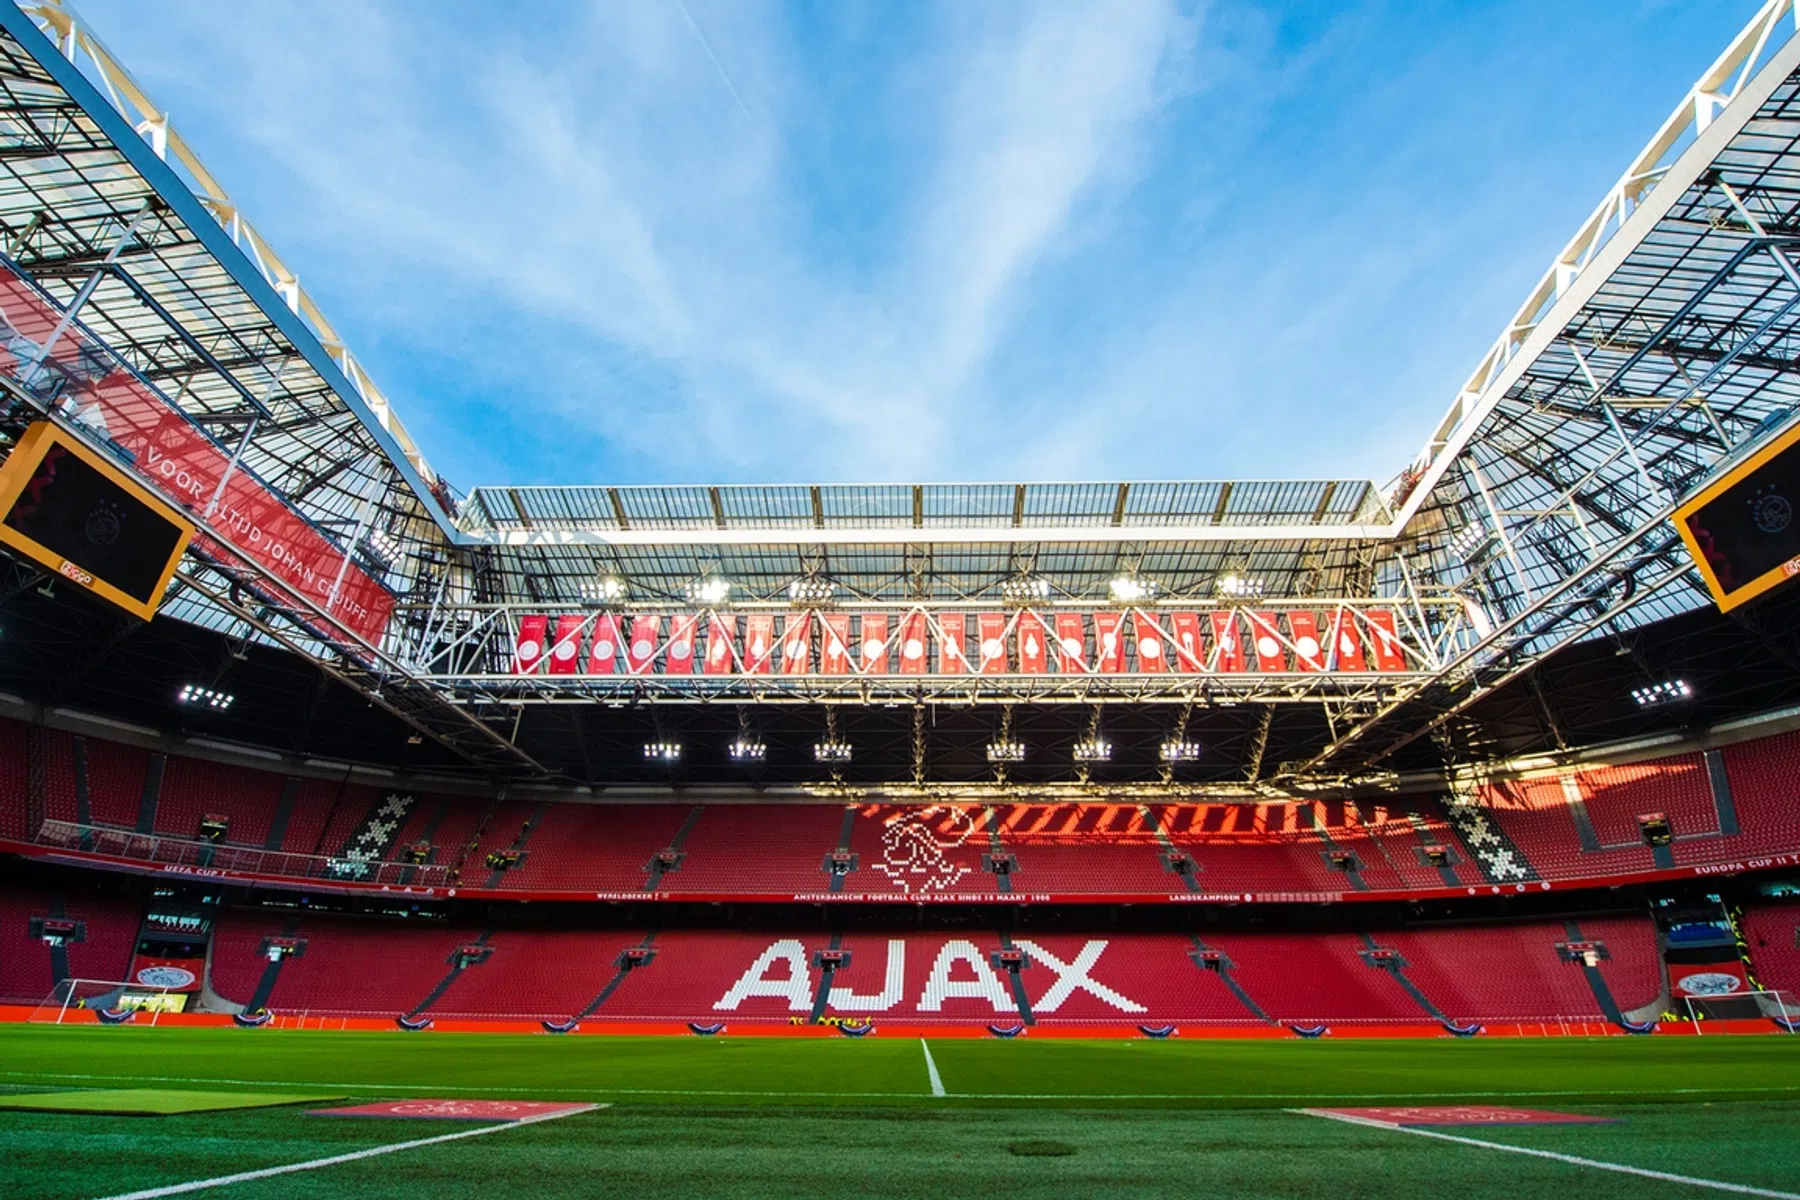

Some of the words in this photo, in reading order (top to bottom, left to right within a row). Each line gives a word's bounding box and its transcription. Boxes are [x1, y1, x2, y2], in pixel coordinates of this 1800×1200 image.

[148, 445, 204, 500] VOOR
[263, 539, 316, 584] JOHAN
[164, 865, 192, 874] UEFA
[196, 868, 218, 876] CUP
[1695, 863, 1745, 875] EUROPA
[1748, 859, 1773, 868] CUP
[867, 893, 907, 901] FOOTBALL
[910, 893, 931, 901] CLUB
[934, 894, 956, 902] AJAX
[712, 938, 1148, 1013] AJAX
